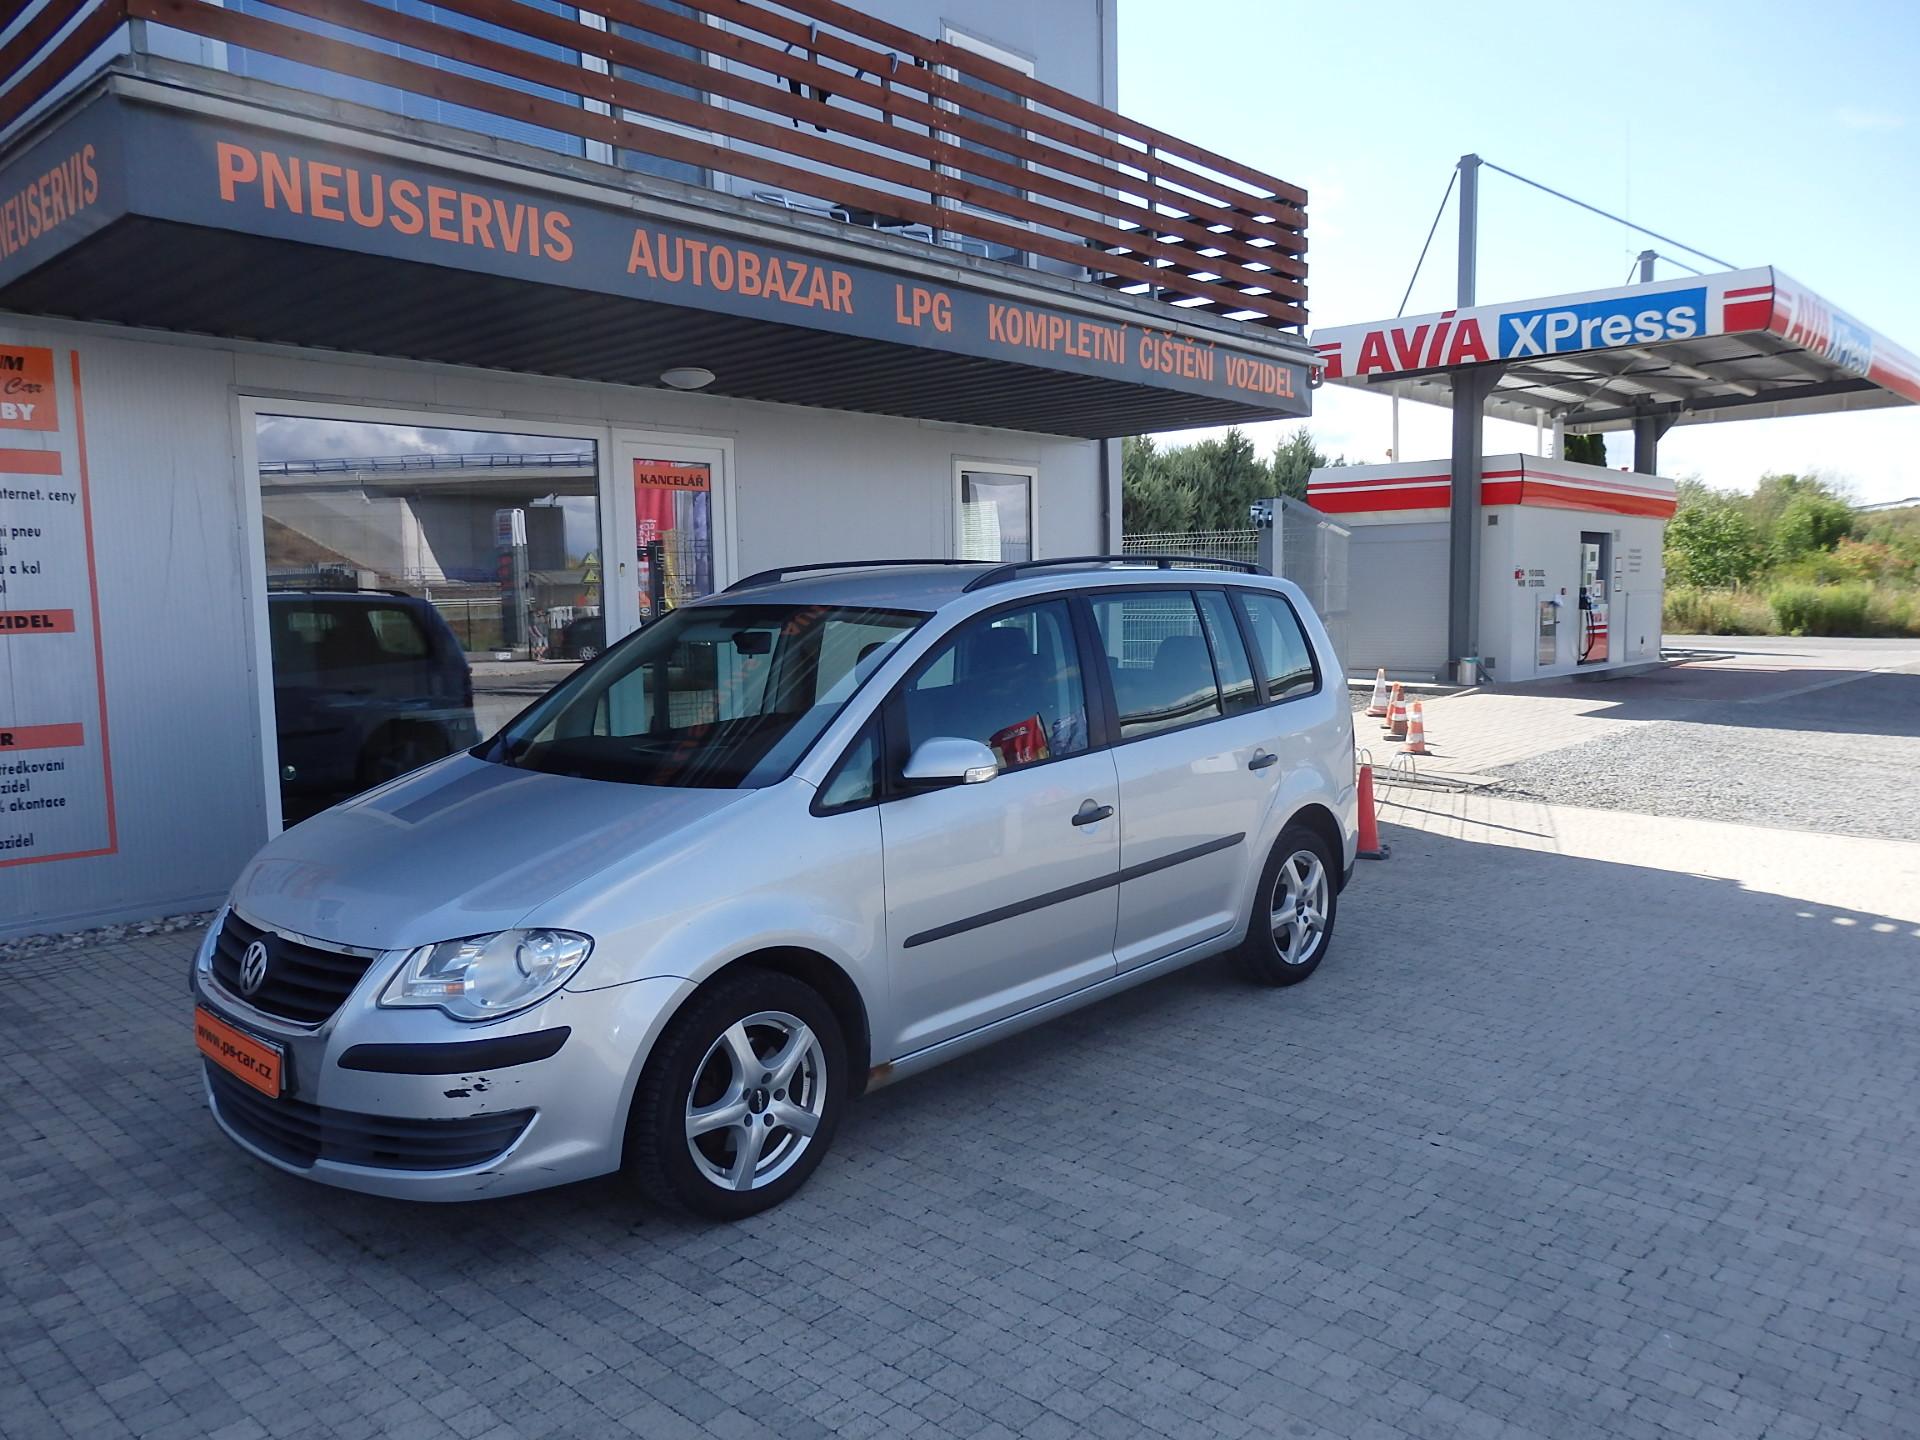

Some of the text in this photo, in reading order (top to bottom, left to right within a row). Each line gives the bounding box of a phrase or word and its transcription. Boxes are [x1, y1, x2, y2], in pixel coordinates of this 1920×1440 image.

[216, 141, 1295, 398] PNEUSERVIS AUTOBAZAR LPG KOMPLETNÍ ČIŠTĚNÍ VOZIDEL
[1508, 306, 1698, 358] XPress
[640, 473, 704, 487] KANCELÁŘ
[48, 491, 76, 504] ceny
[11, 527, 41, 540] pneu
[9, 565, 17, 575] a
[21, 560, 41, 575] kol
[9, 797, 66, 812] akontace
[197, 1025, 273, 1080] www.ps-car.cz
